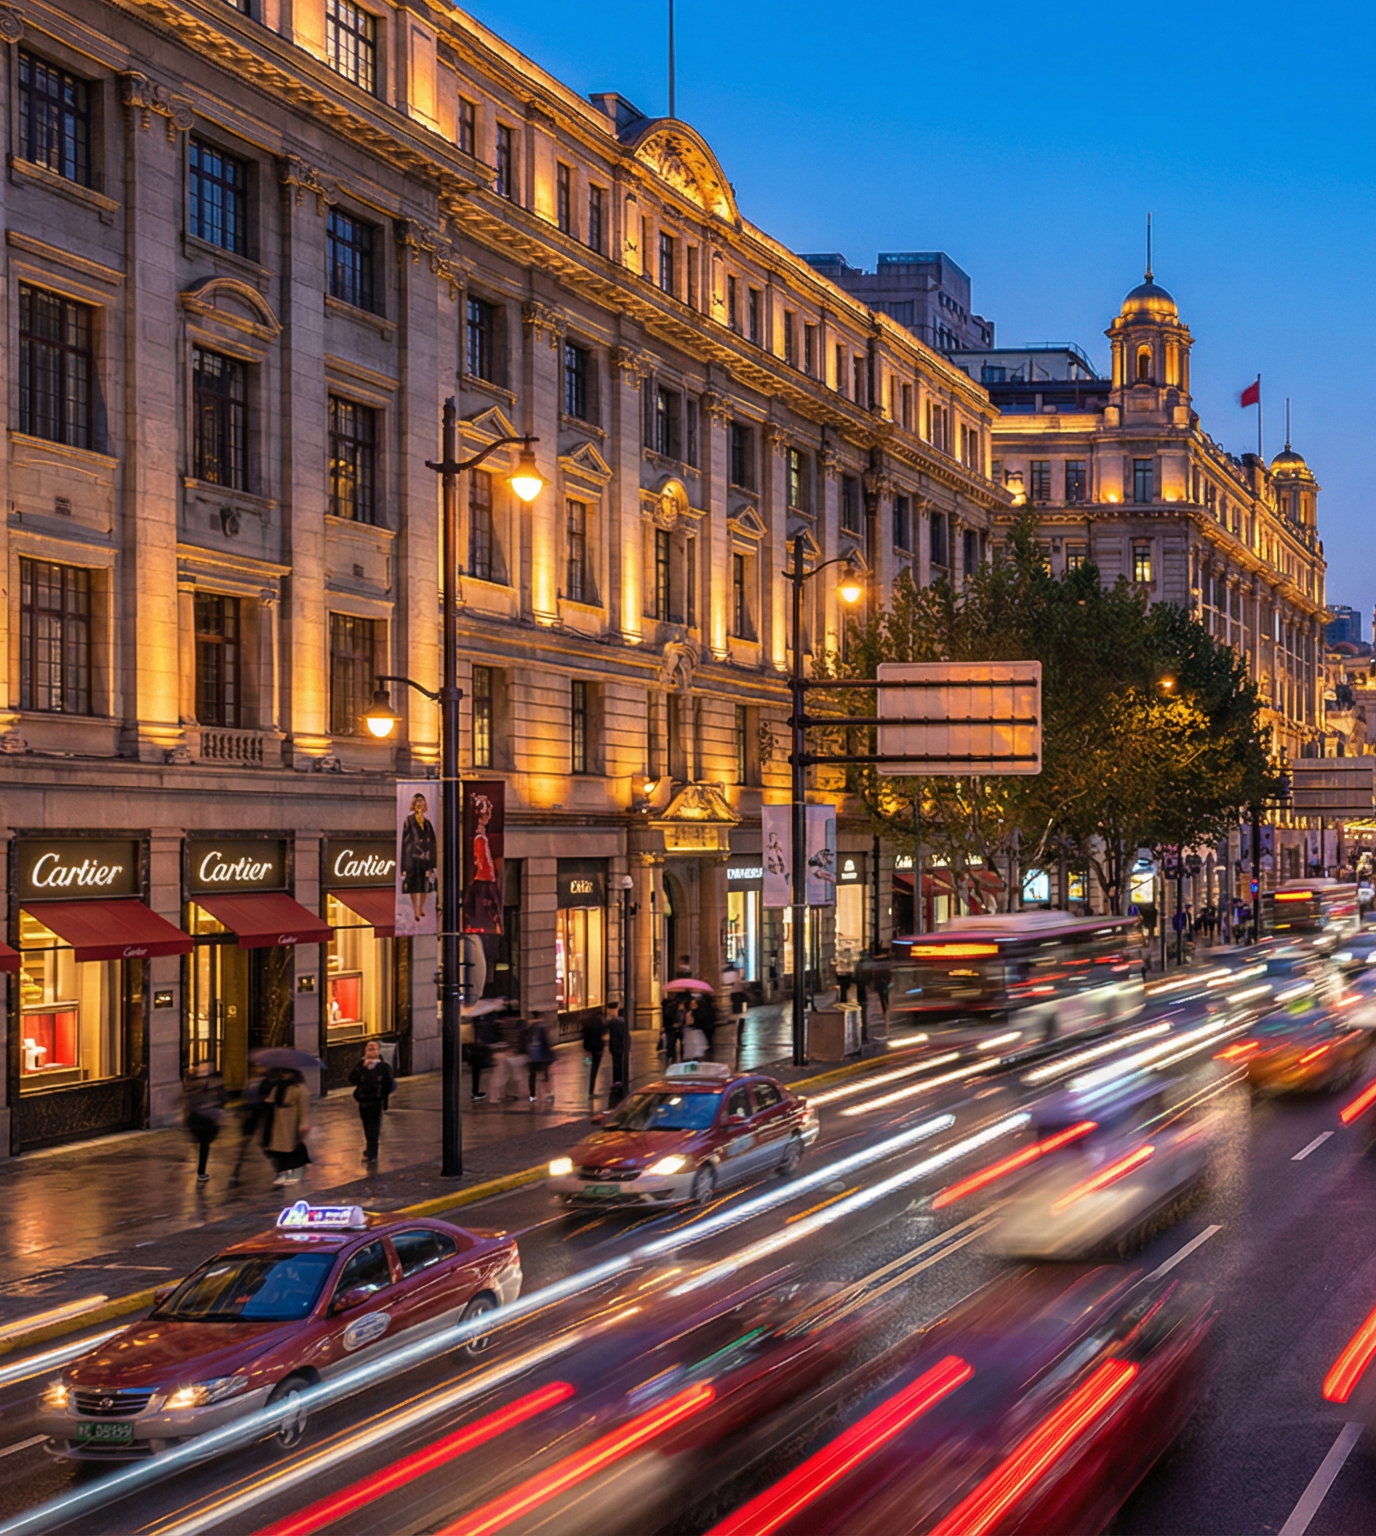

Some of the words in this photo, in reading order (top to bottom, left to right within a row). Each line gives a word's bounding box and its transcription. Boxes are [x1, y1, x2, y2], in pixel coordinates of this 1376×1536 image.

[31, 852, 123, 887] Cartier
[199, 851, 272, 882] Cartier
[334, 849, 396, 877] Cartier
